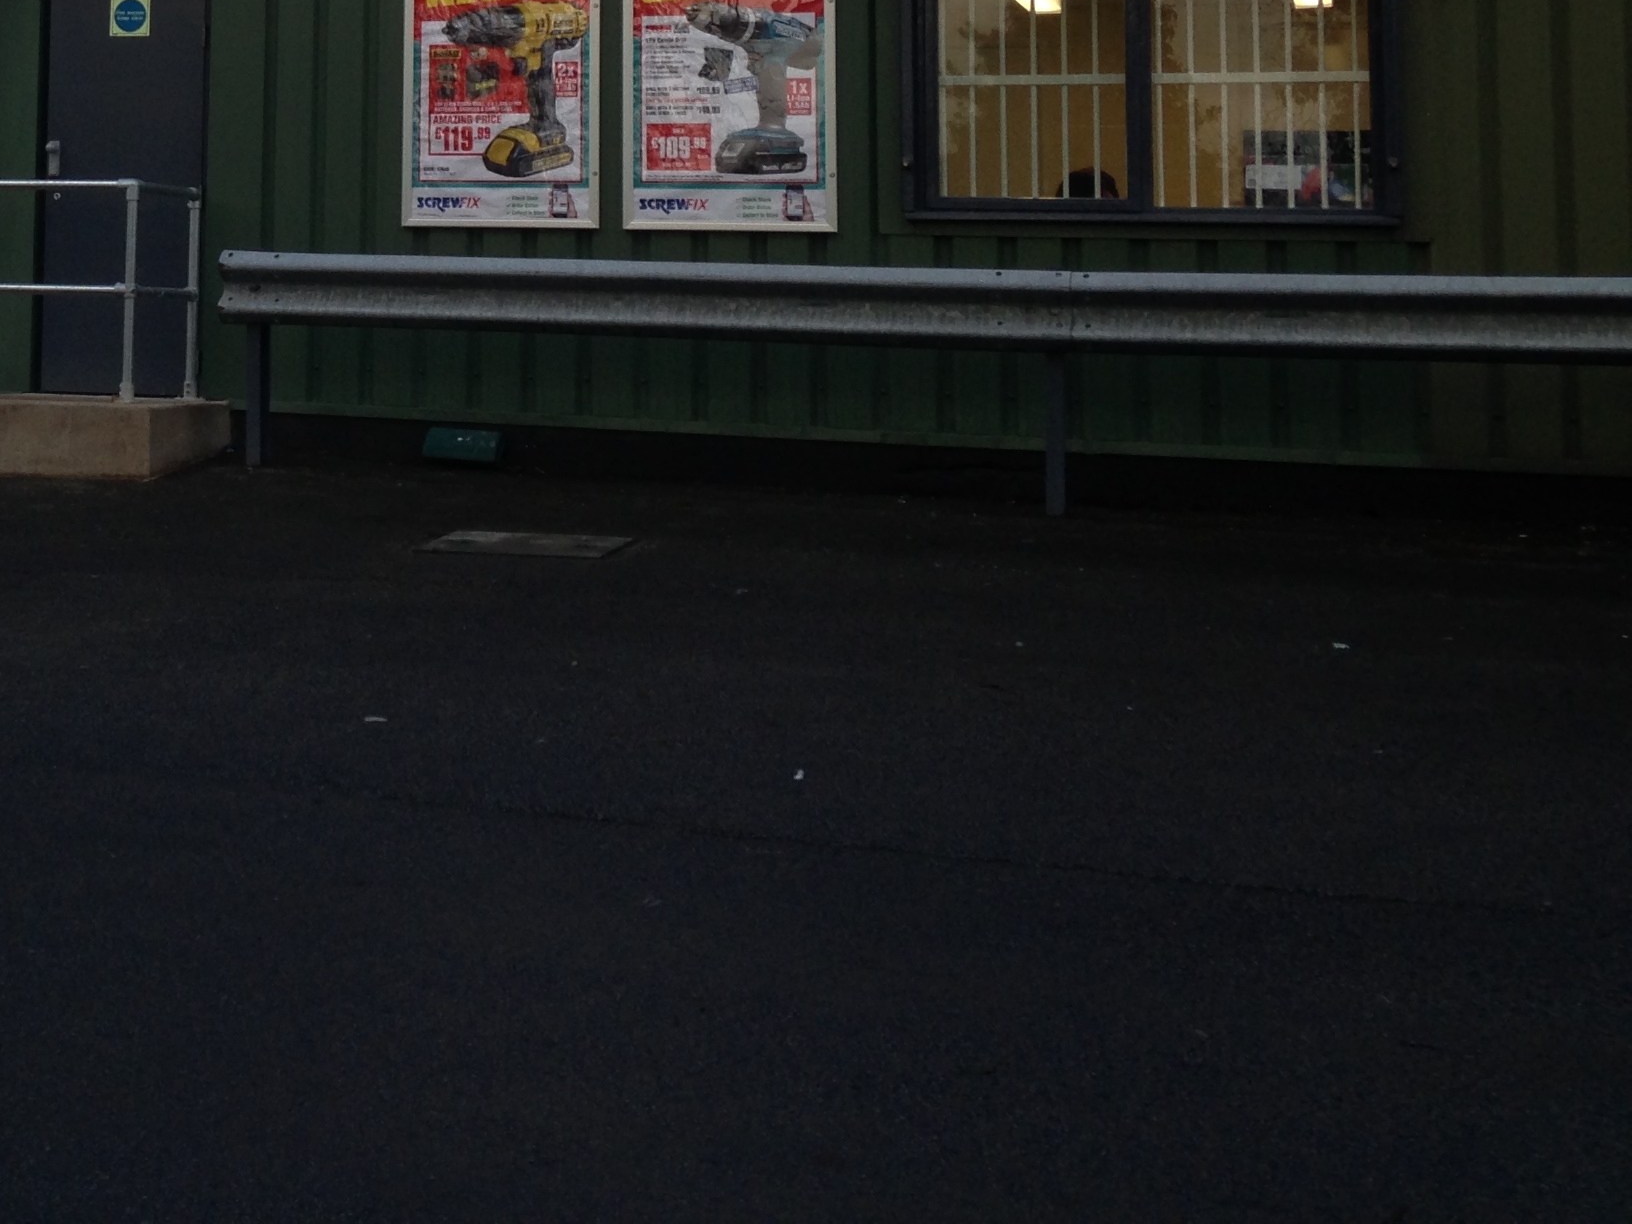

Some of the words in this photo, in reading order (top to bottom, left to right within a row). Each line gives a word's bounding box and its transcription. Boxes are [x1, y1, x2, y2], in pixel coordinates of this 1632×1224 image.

[433, 116, 473, 124] AMAZING
[476, 116, 501, 124] PRICE
[417, 196, 481, 212] SCREWFIX
[639, 199, 709, 214] SCREWFIX
